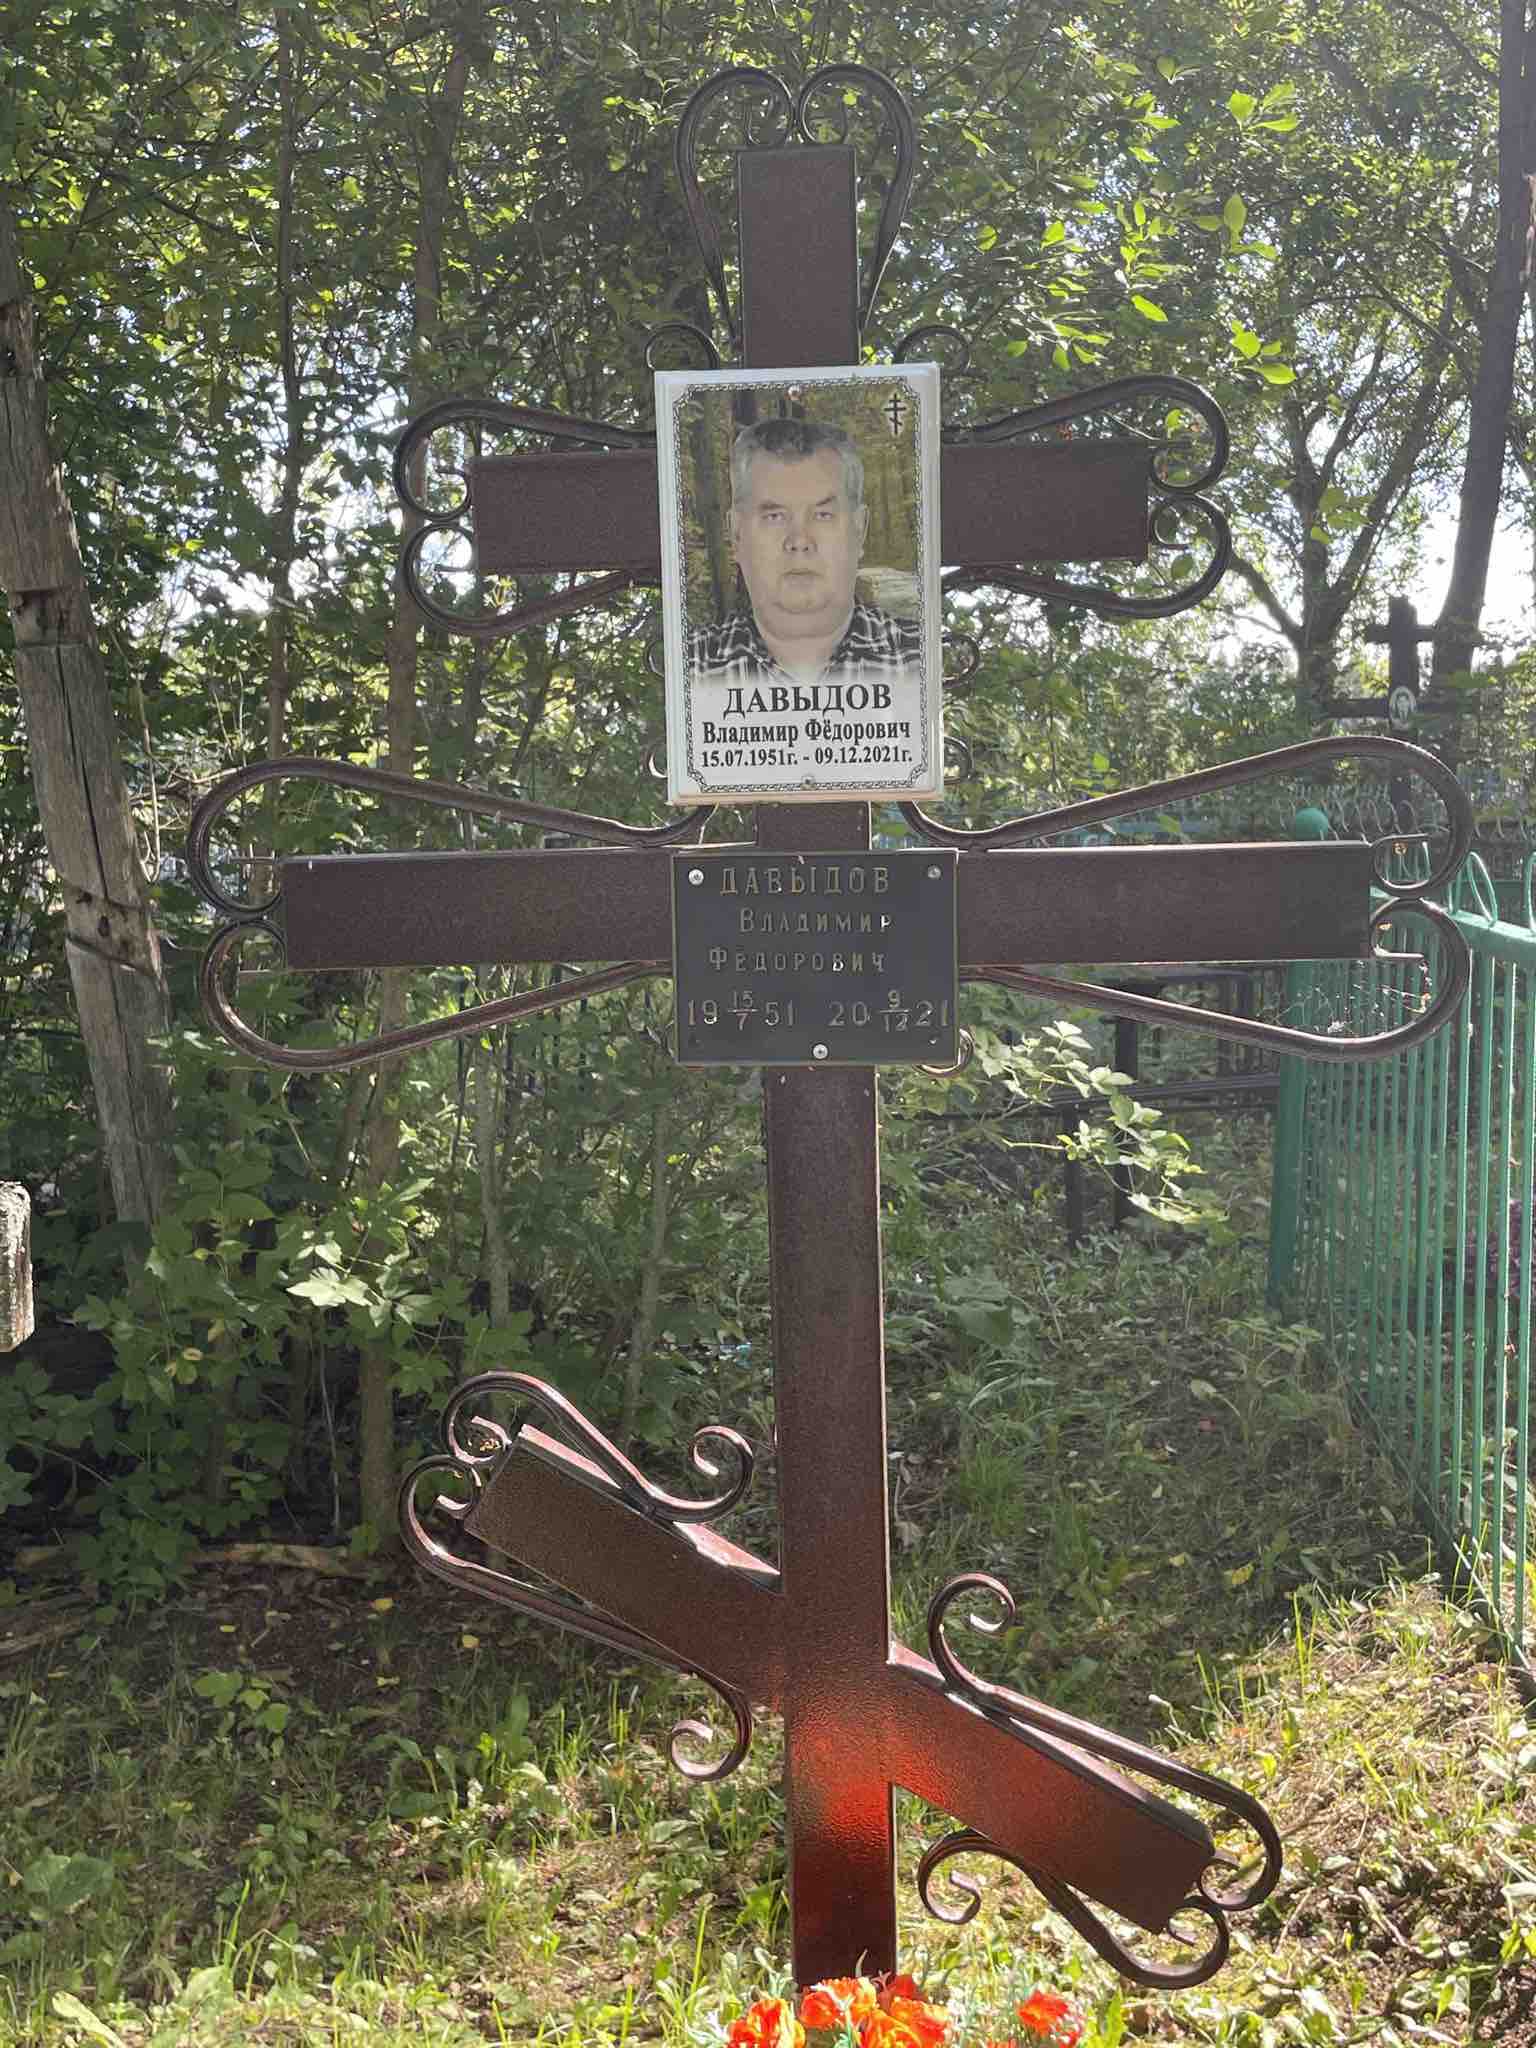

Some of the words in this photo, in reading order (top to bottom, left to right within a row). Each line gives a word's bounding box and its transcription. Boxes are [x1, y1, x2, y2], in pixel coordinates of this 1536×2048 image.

[723, 683, 892, 719] ДАВЫДОВ
[703, 721, 799, 747] Владимир
[805, 718, 911, 743] Фёдорович
[701, 749, 798, 768] 15.07.1951г.
[815, 747, 913, 765] 09.12.2021г.
[720, 867, 889, 894] ДАВЫДОВ
